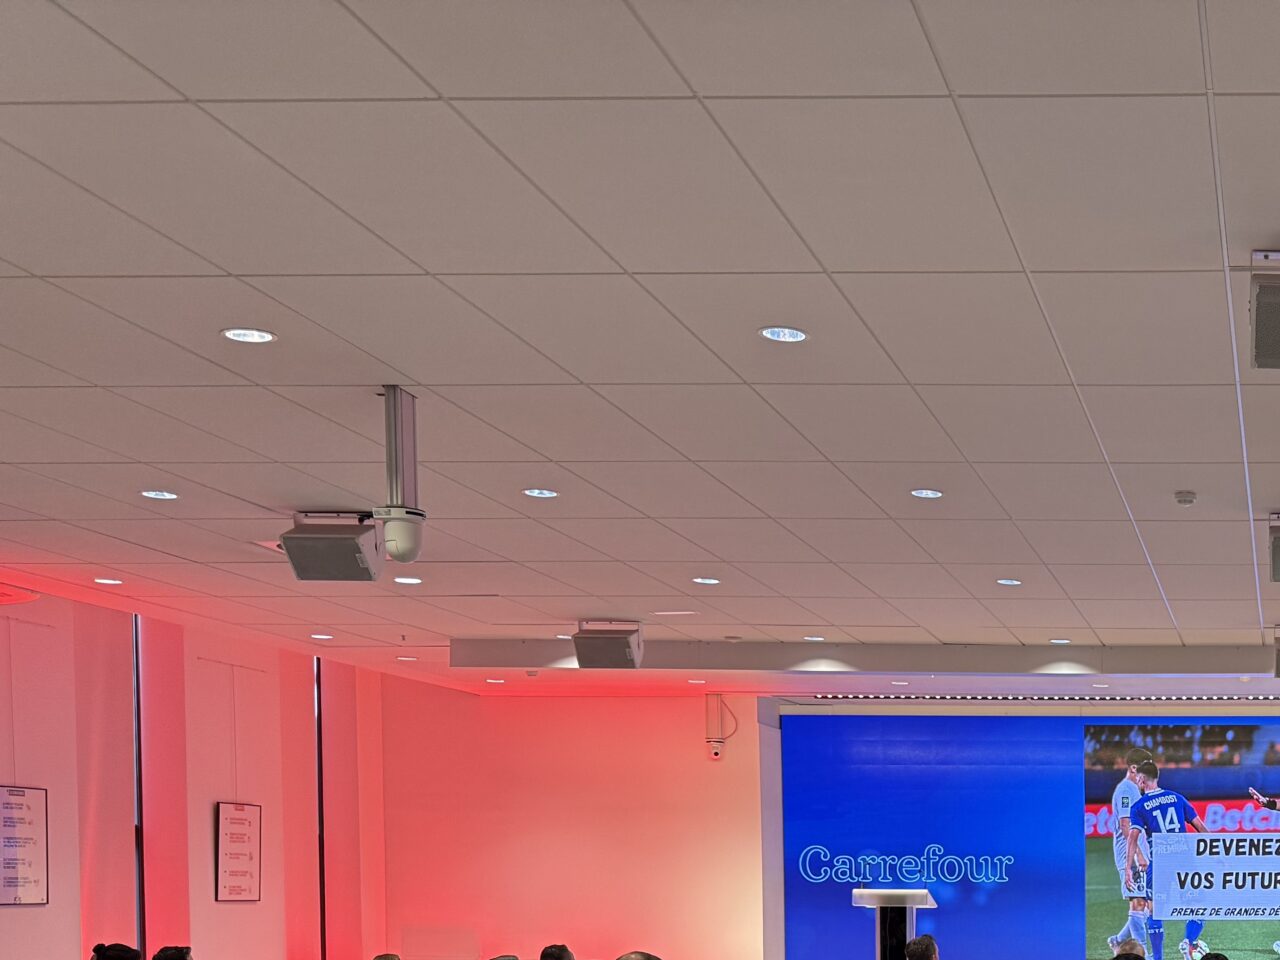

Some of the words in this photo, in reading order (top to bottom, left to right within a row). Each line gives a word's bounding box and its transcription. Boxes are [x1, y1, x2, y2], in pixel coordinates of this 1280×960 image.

[1152, 806, 1181, 834] 14
[799, 844, 1014, 883] Carrefour
[1176, 871, 1215, 890] VOS
[1170, 907, 1207, 917] PRENEZ
[1209, 907, 1222, 917] DE
[1224, 907, 1266, 917] GRANDES
